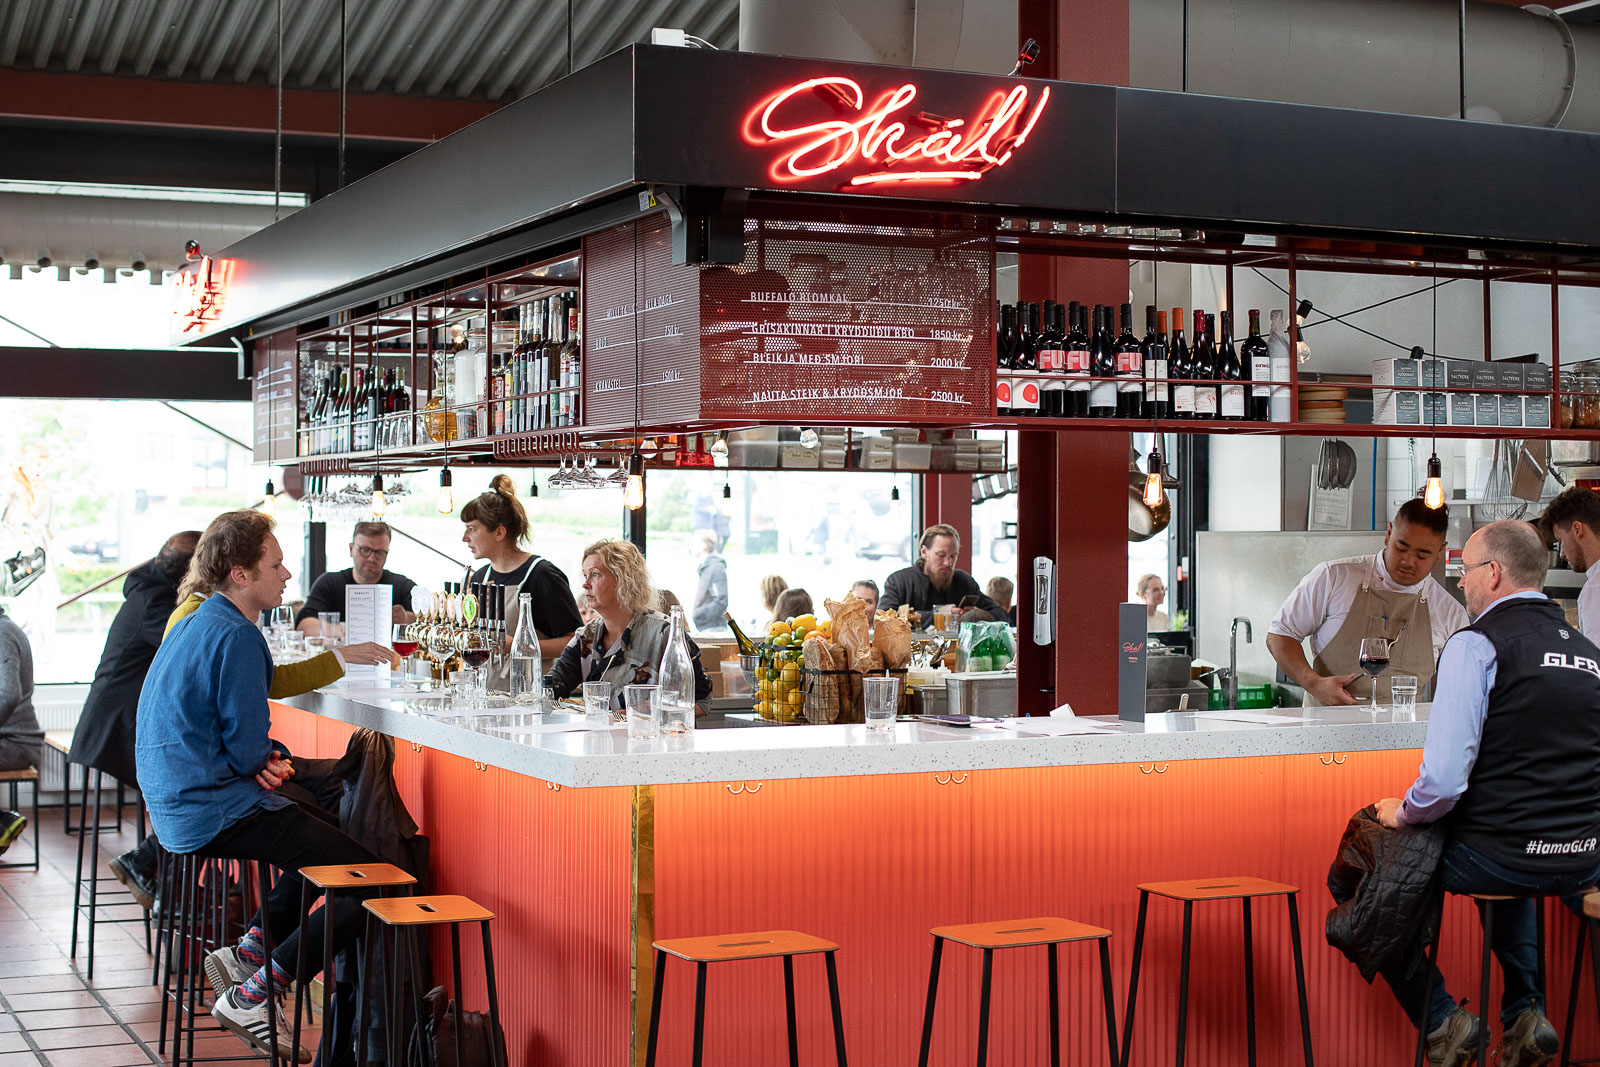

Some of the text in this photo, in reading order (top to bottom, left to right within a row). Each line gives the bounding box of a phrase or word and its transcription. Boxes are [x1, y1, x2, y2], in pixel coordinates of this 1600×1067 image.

[752, 76, 1051, 178] Skál!
[750, 291, 796, 302] BUFFALO
[928, 297, 951, 308] 1250
[929, 329, 951, 340] 1850
[753, 352, 796, 364] BLEIKJA
[930, 357, 953, 368] 2000
[752, 390, 788, 402] NAUTA
[790, 388, 820, 401] STEIK
[822, 387, 830, 398] &
[930, 390, 953, 402] 2500
[1525, 837, 1597, 855] #iamaGLFR
